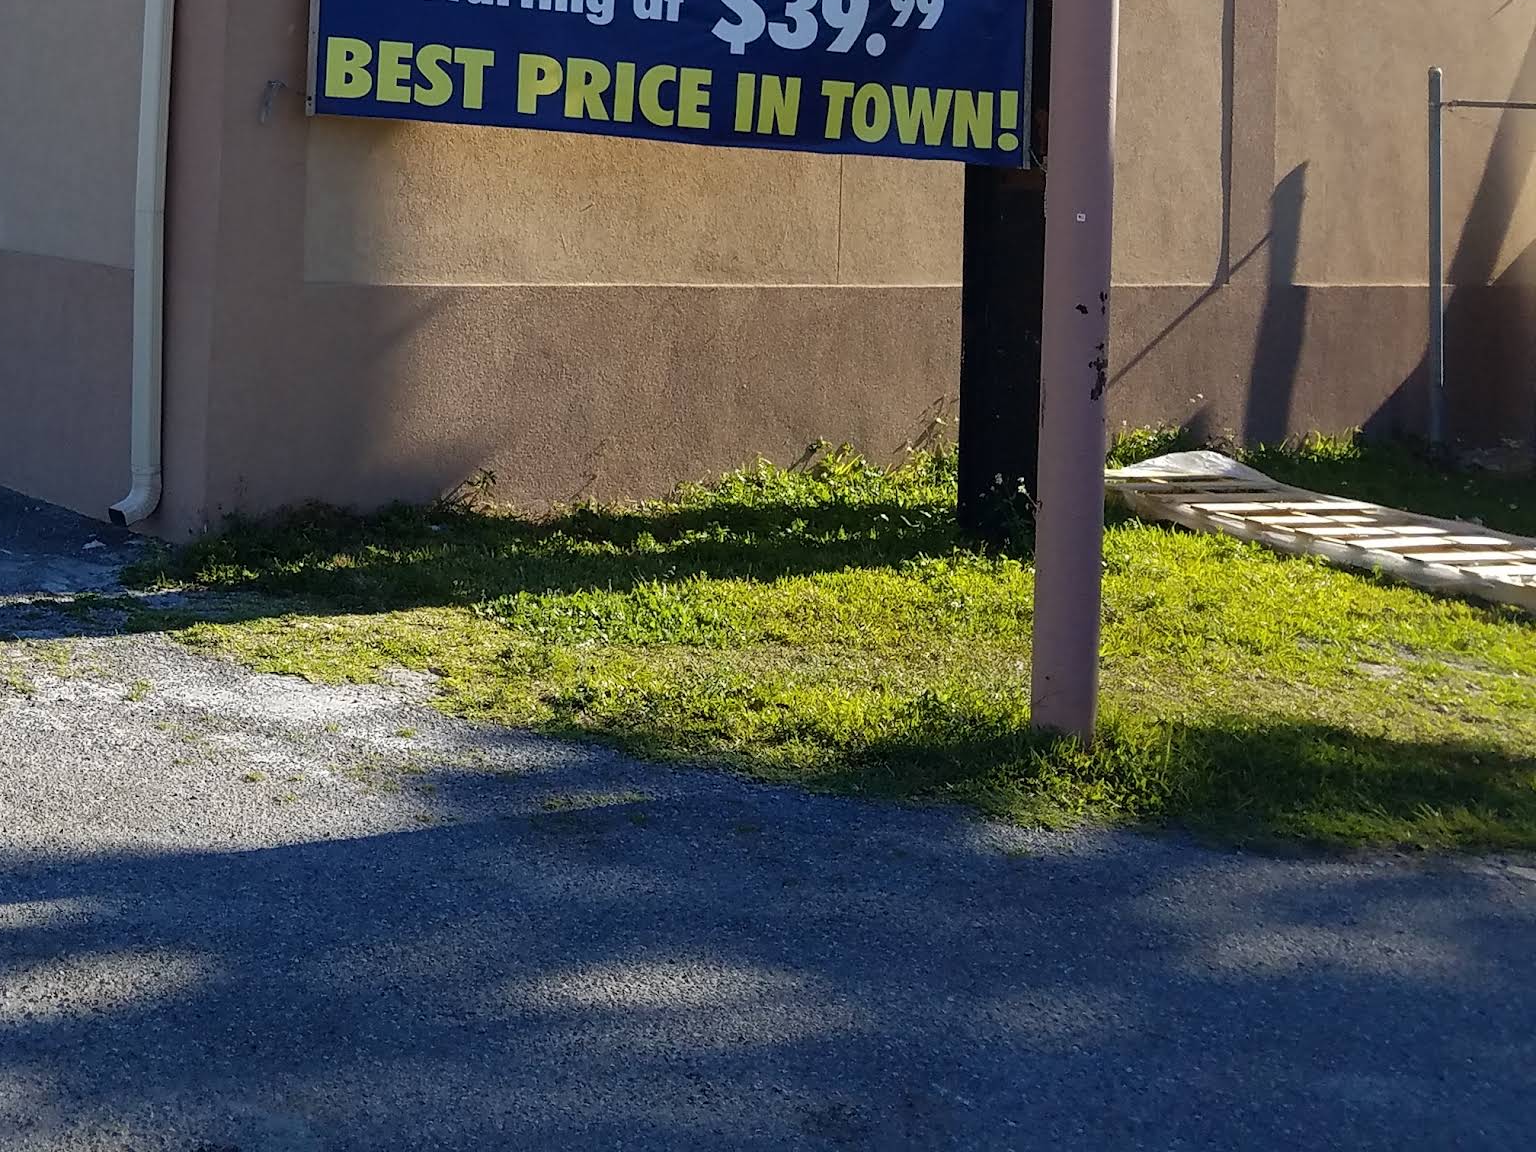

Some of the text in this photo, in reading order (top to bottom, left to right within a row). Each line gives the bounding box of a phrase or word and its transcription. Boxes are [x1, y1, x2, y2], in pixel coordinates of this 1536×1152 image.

[323, 36, 1020, 152] BEST PRICE IN TOWN!
